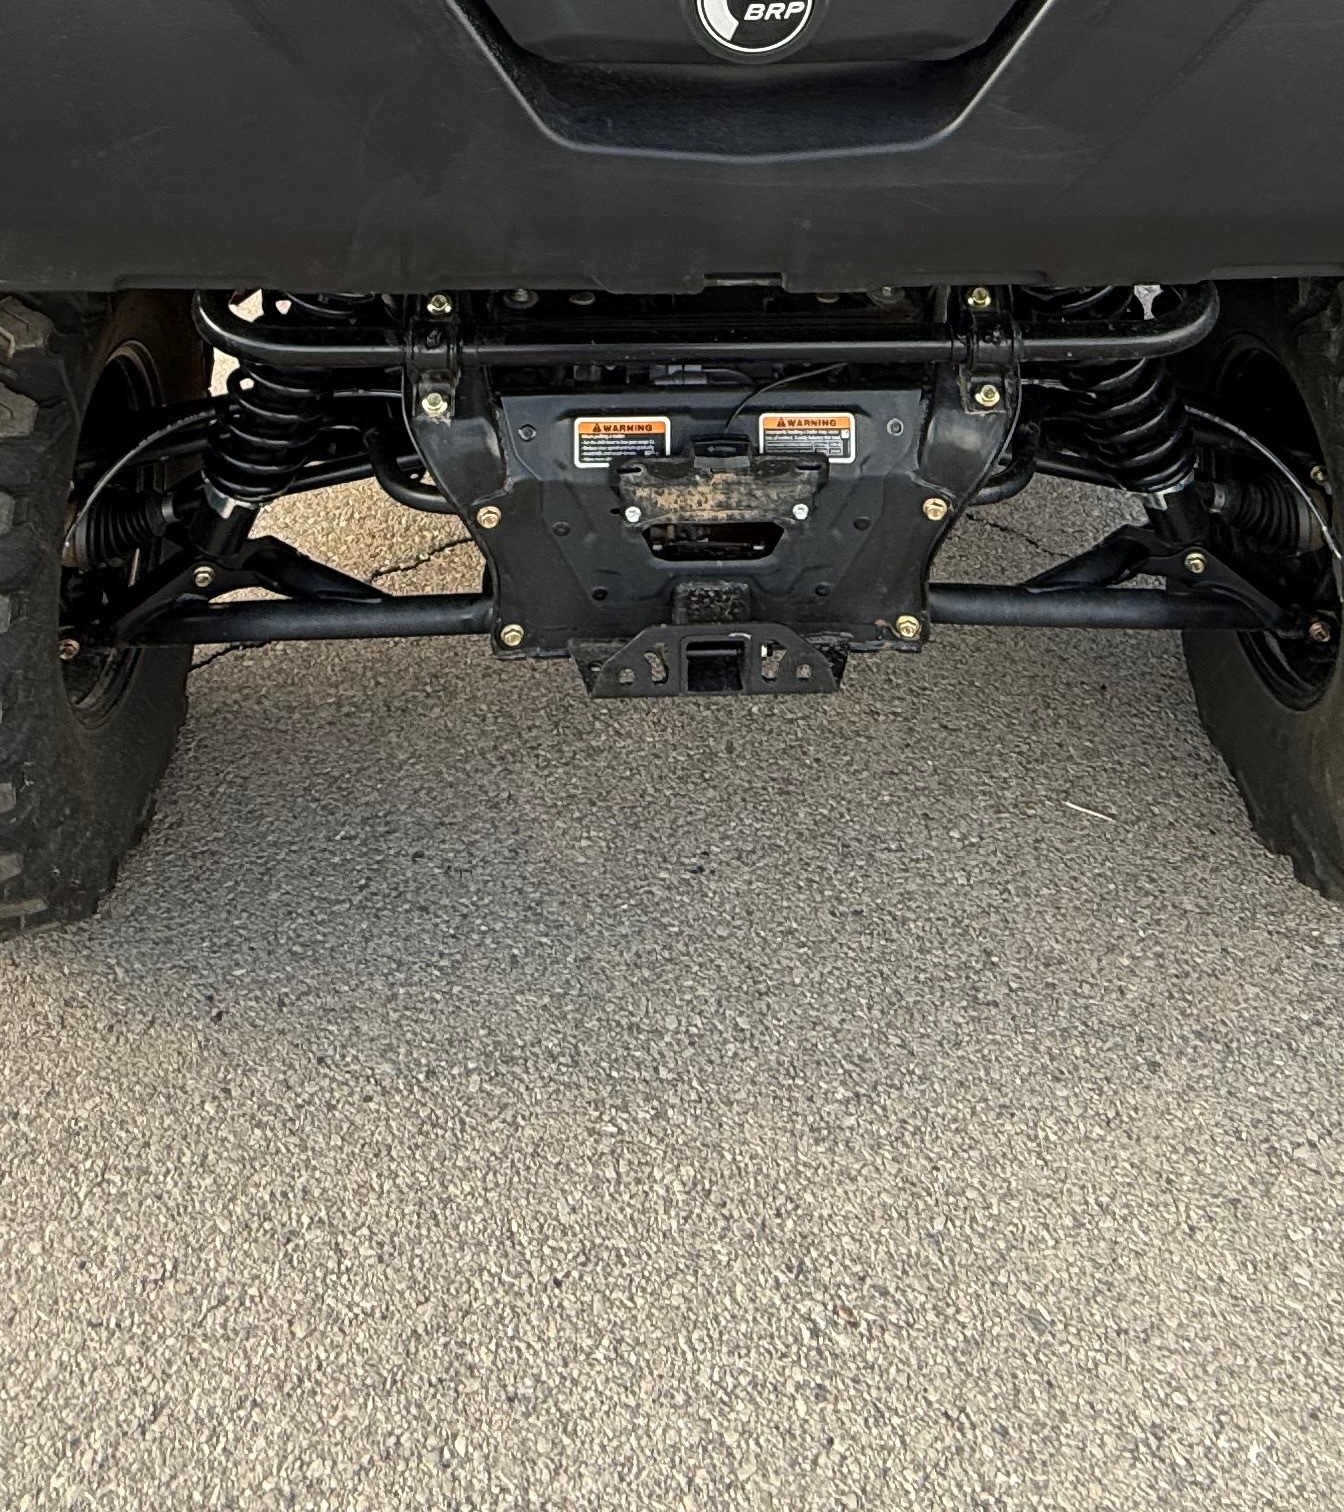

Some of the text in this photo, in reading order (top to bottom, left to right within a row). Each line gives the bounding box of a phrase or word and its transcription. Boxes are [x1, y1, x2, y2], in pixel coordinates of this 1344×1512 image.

[743, 1, 805, 21] BRP
[602, 423, 653, 433] WARNING
[787, 418, 837, 428] WARNING
